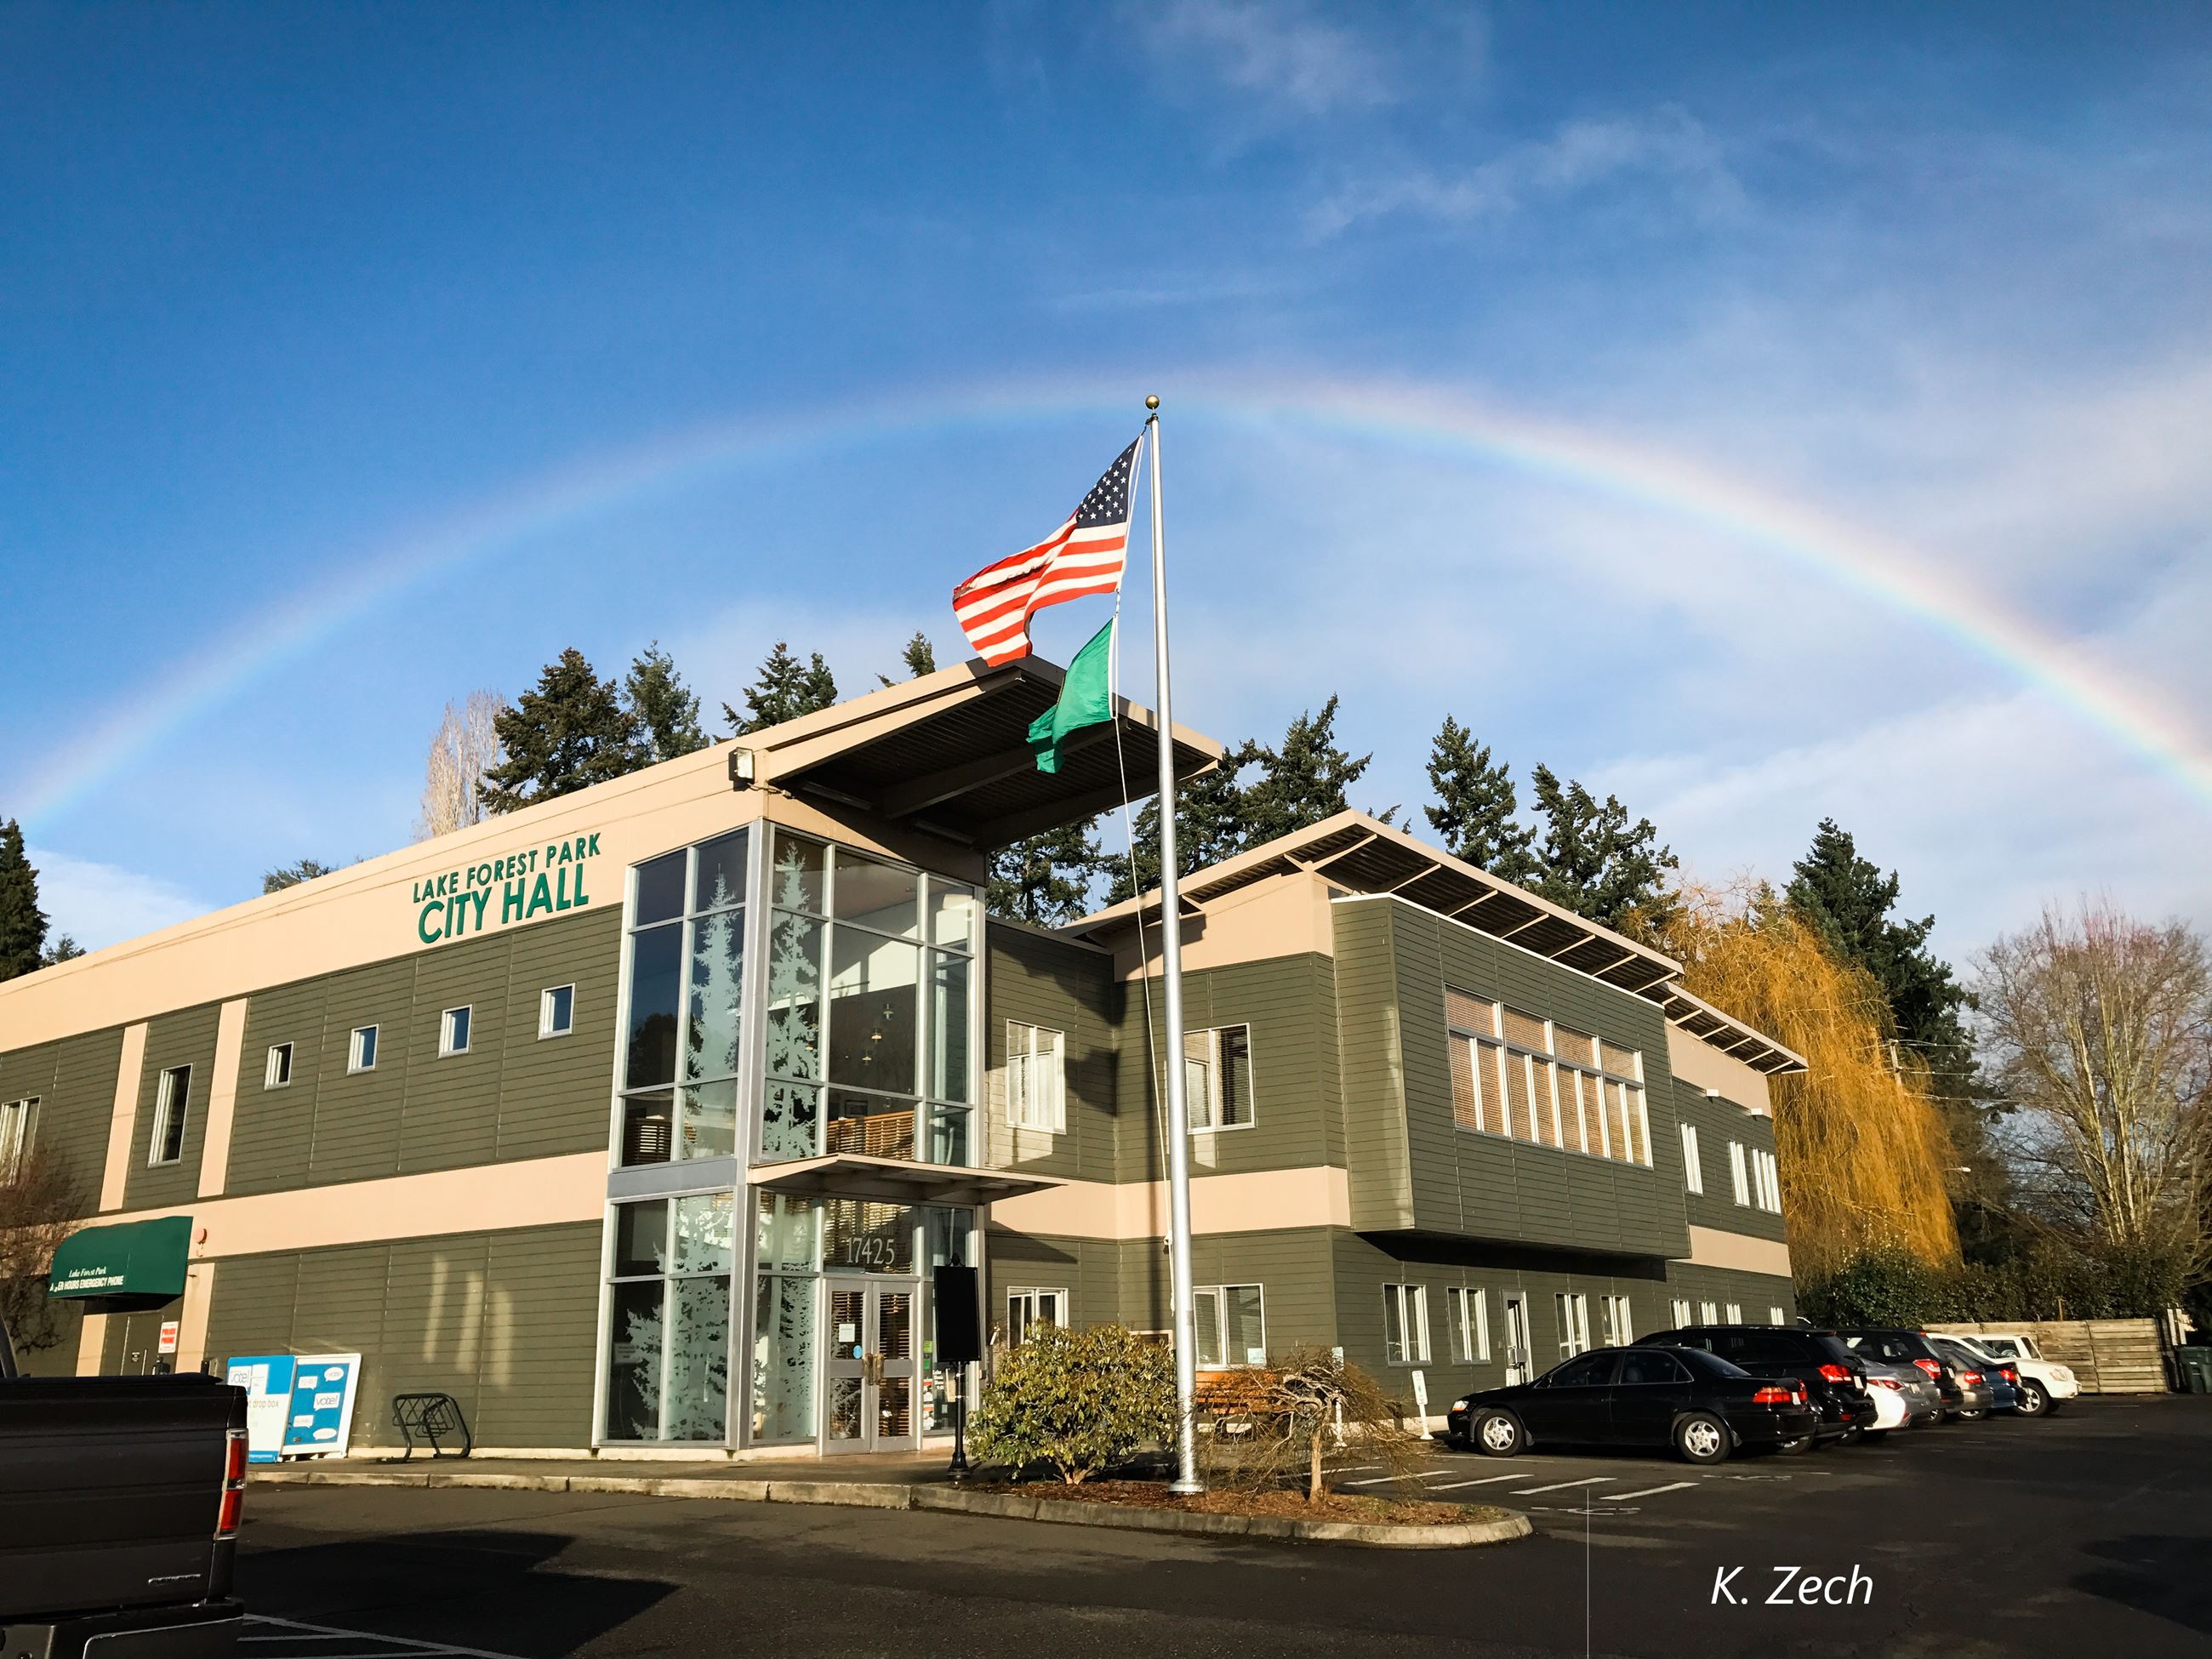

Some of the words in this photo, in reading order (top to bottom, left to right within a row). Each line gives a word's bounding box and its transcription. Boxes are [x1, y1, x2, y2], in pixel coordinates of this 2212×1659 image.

[413, 871, 459, 904] LAKE
[466, 850, 538, 889] FOREST
[546, 832, 601, 868] PARK
[418, 887, 493, 944] CITY
[501, 863, 589, 924] HALL
[847, 1237, 895, 1265] 17425
[253, 1399, 266, 1409] drop
[267, 1400, 280, 1408] box
[316, 1395, 339, 1406] vote!
